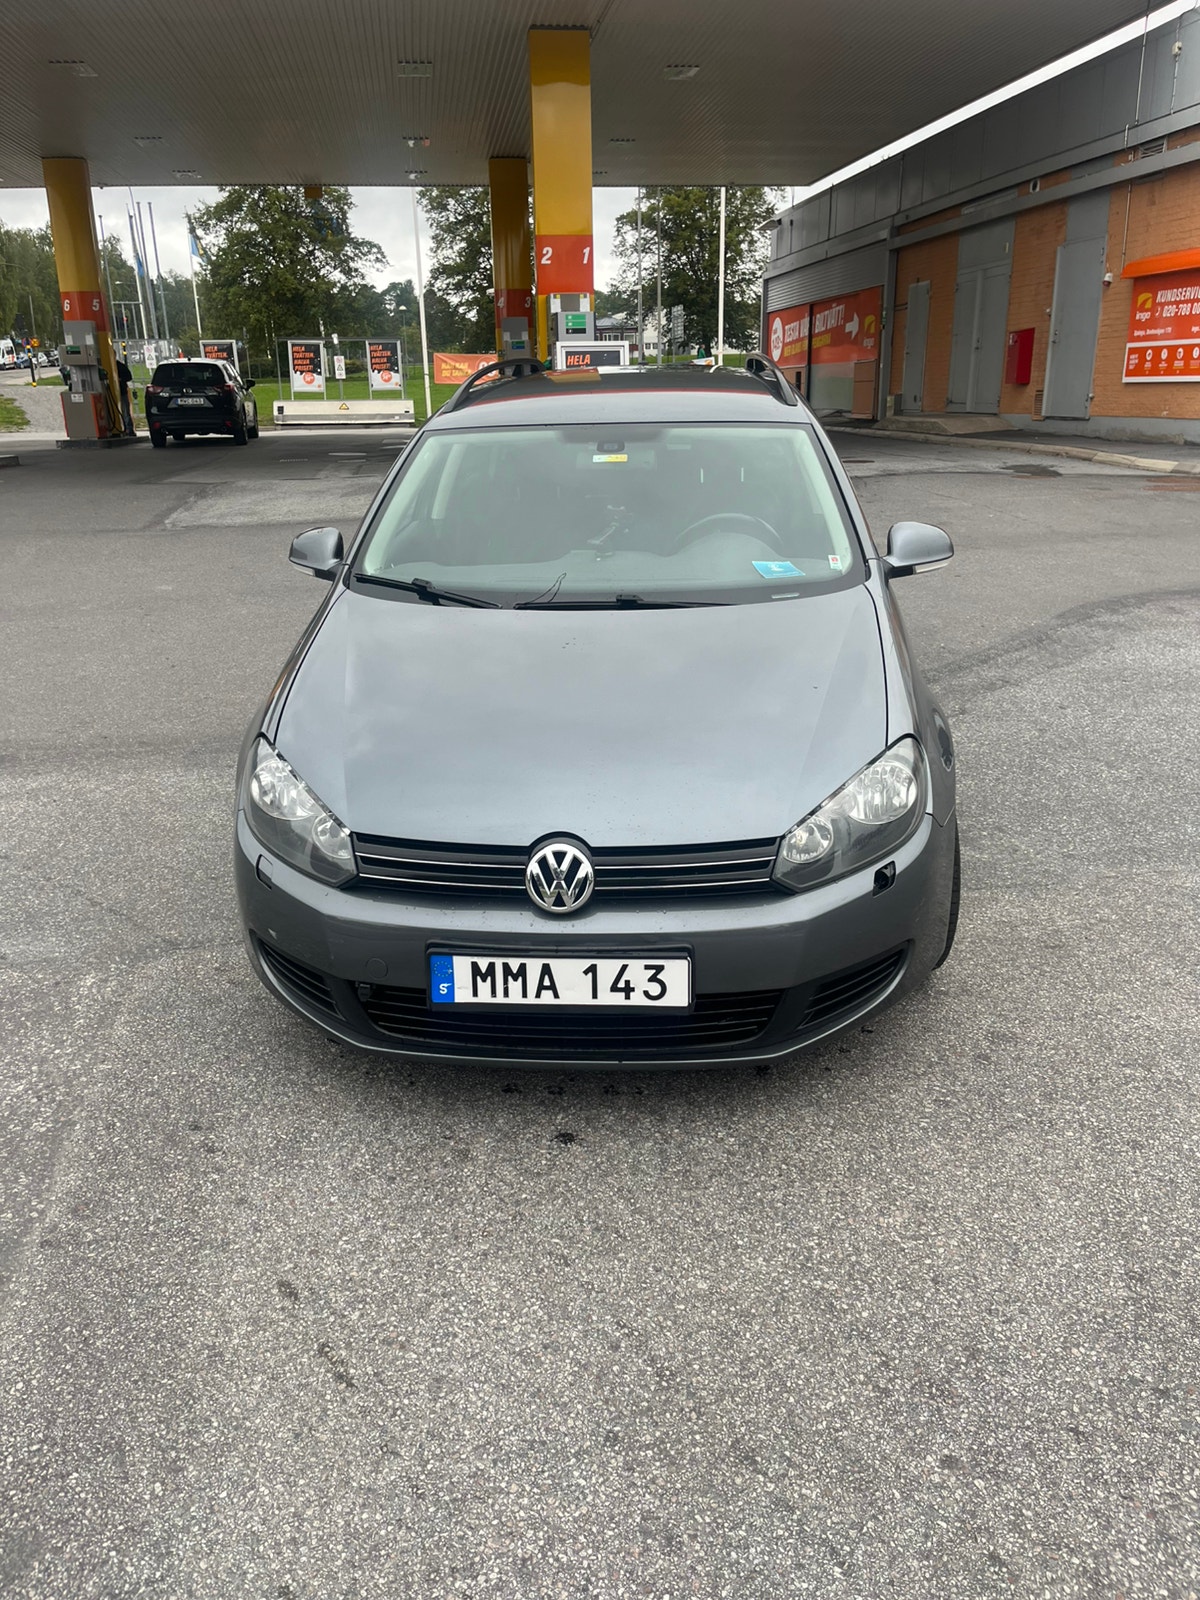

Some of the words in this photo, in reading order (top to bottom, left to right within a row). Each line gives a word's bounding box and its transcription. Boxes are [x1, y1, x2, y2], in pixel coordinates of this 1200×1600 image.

[541, 246, 553, 265] 2
[582, 246, 591, 265] 1
[63, 299, 70, 312] 6
[92, 299, 100, 311] 5
[497, 297, 505, 308] 4
[525, 296, 532, 308] 3
[566, 354, 591, 366] HELA
[470, 961, 560, 999] MMA
[582, 963, 668, 1001] 143
[439, 983, 448, 995] S
